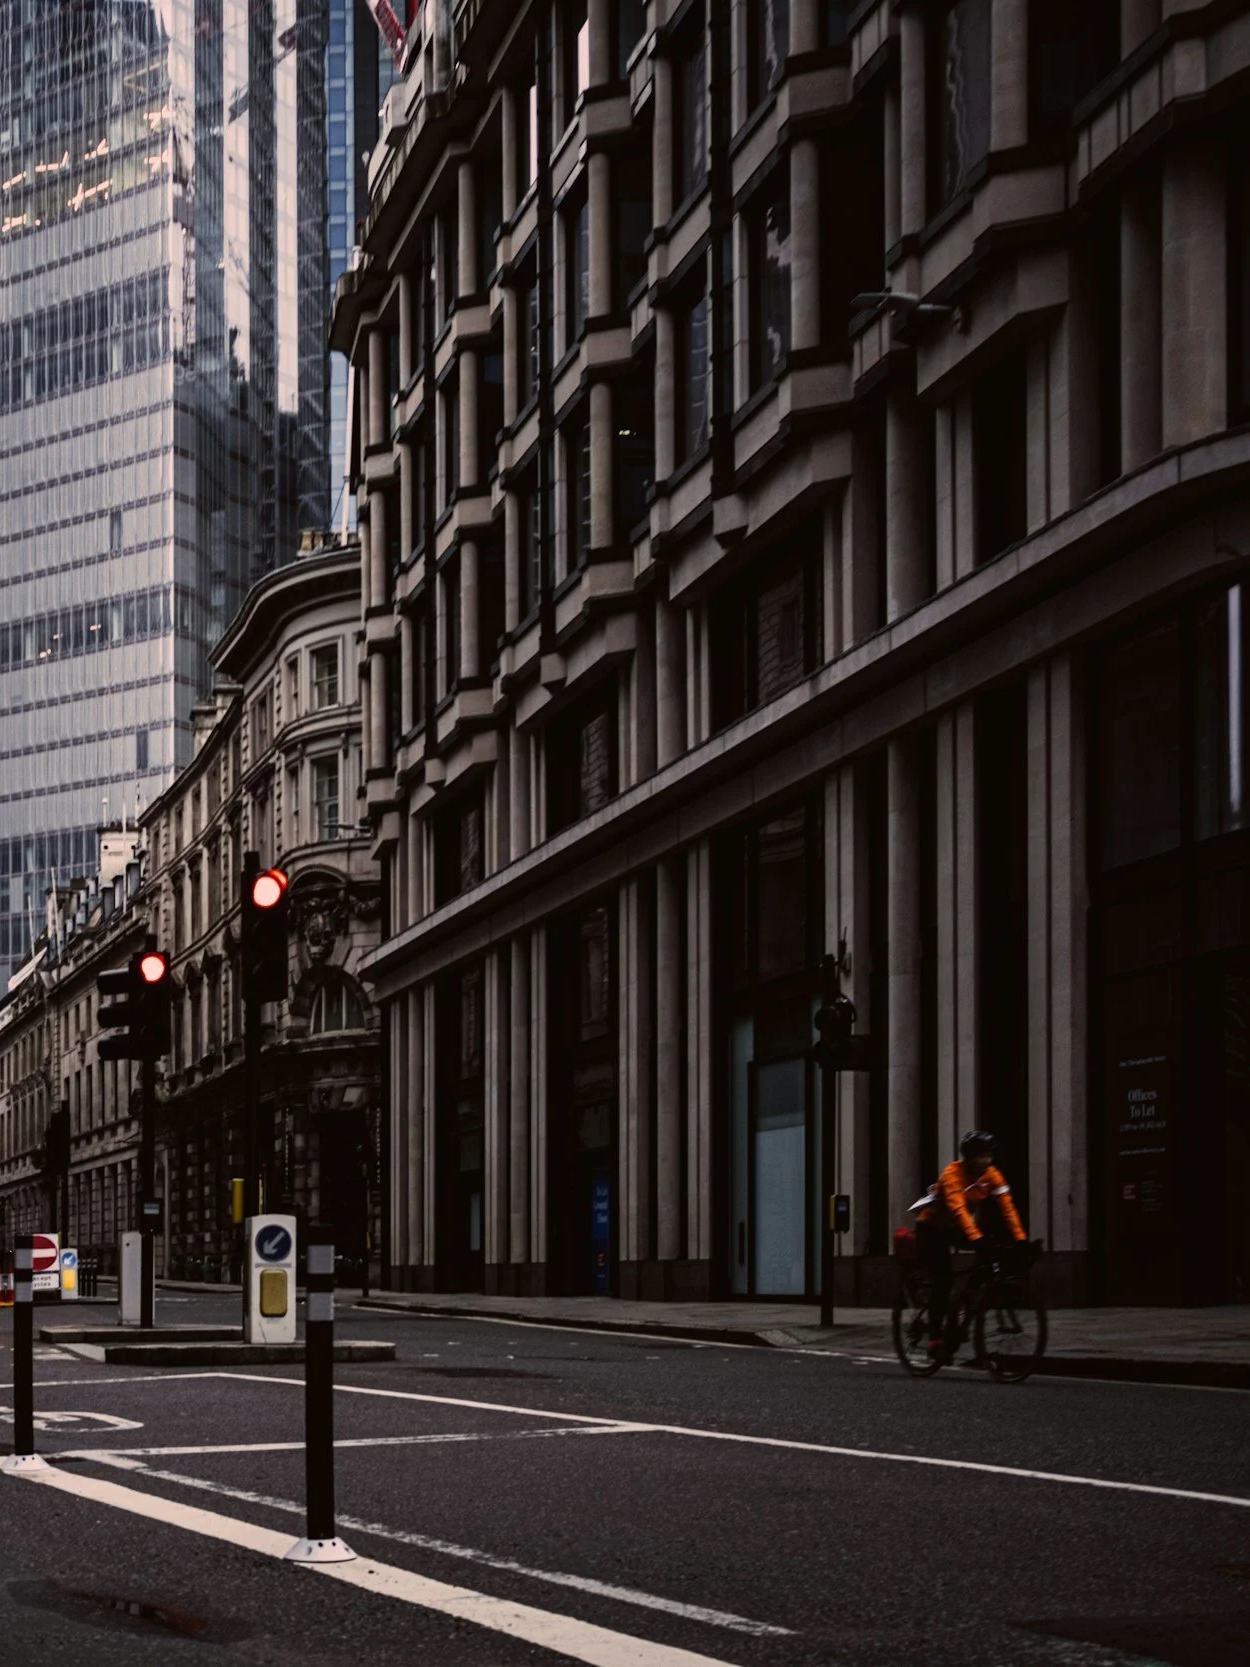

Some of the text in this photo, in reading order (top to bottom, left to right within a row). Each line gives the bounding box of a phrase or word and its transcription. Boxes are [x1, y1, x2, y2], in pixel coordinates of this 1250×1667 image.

[1127, 1088, 1158, 1102] Offices
[1129, 1103, 1156, 1119] To Let
